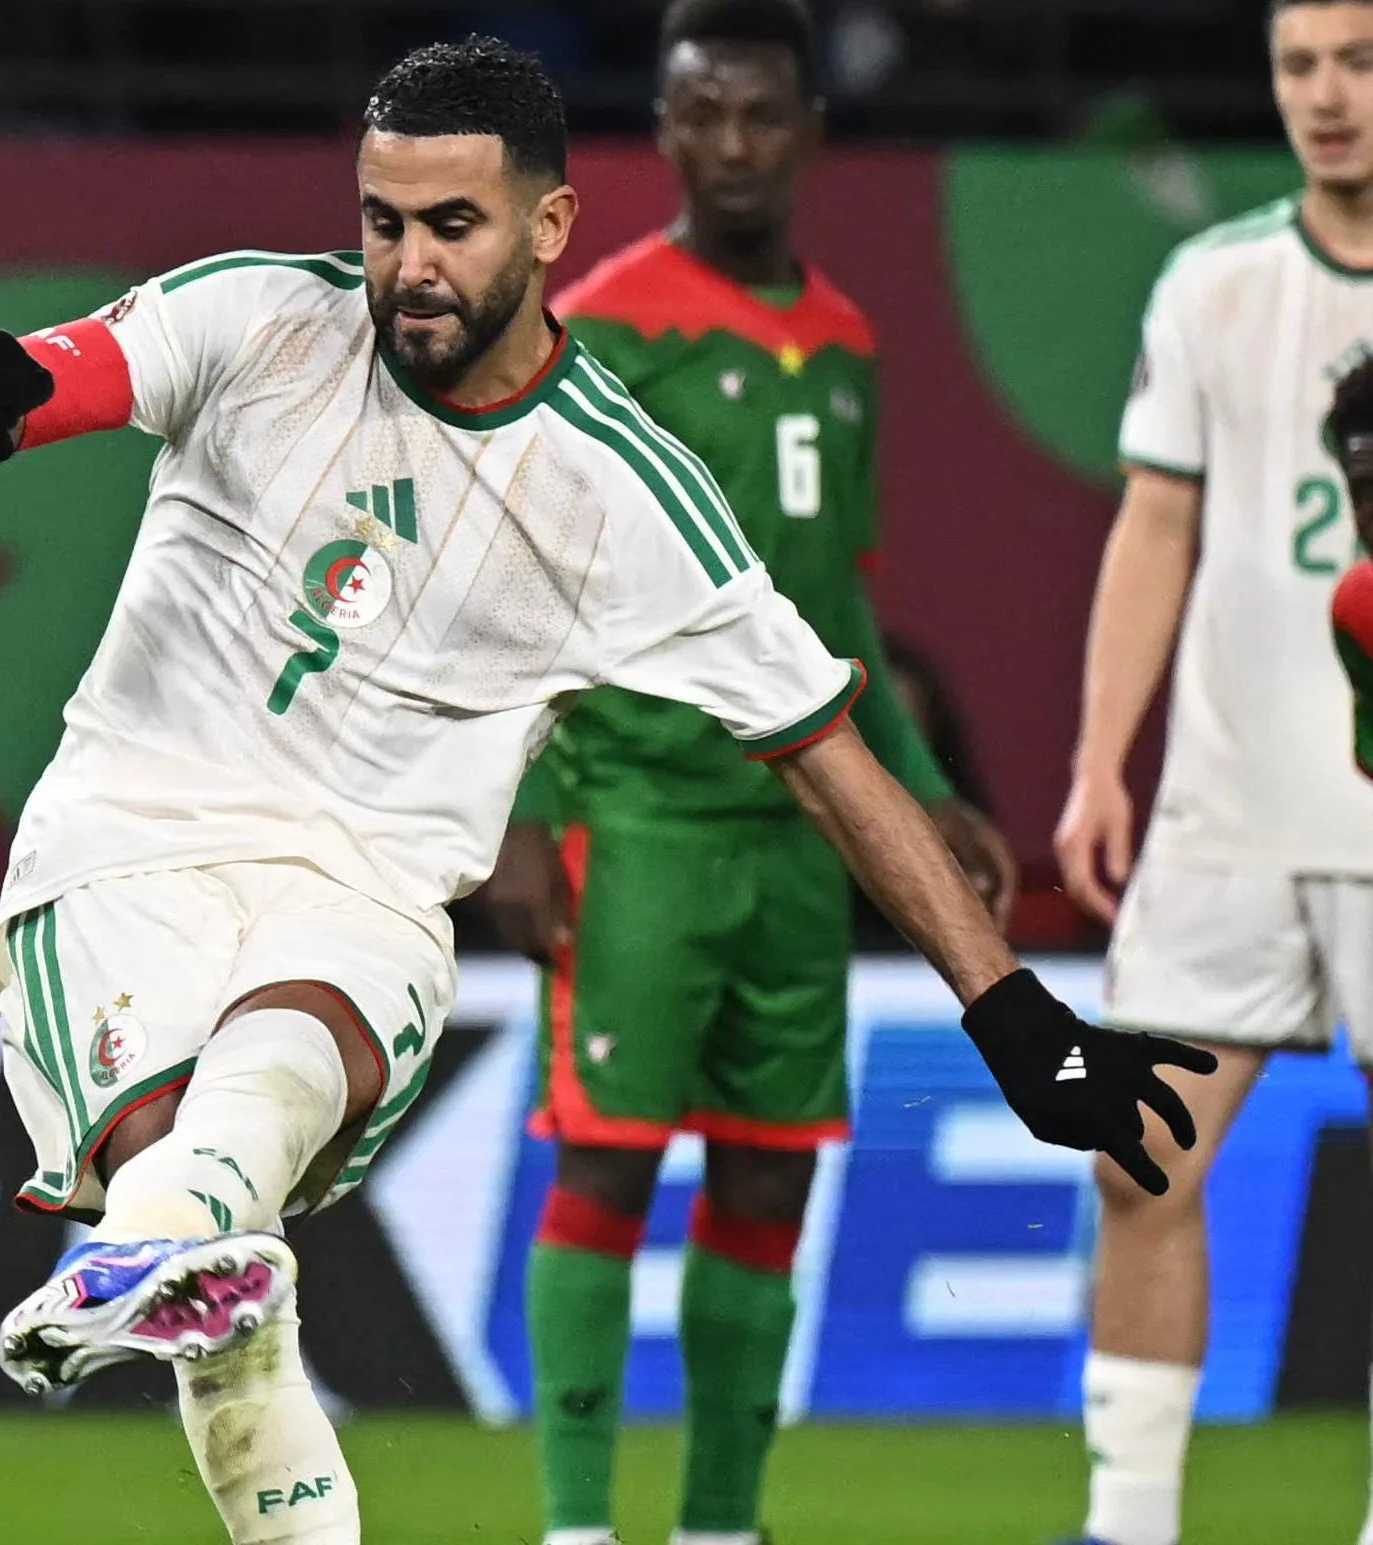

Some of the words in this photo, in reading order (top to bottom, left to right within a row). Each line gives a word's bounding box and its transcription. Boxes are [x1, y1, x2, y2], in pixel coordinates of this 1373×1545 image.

[776, 413, 821, 518] 6
[1294, 476, 1366, 573] 2
[266, 609, 340, 716] 7
[256, 1476, 333, 1515] FAF
